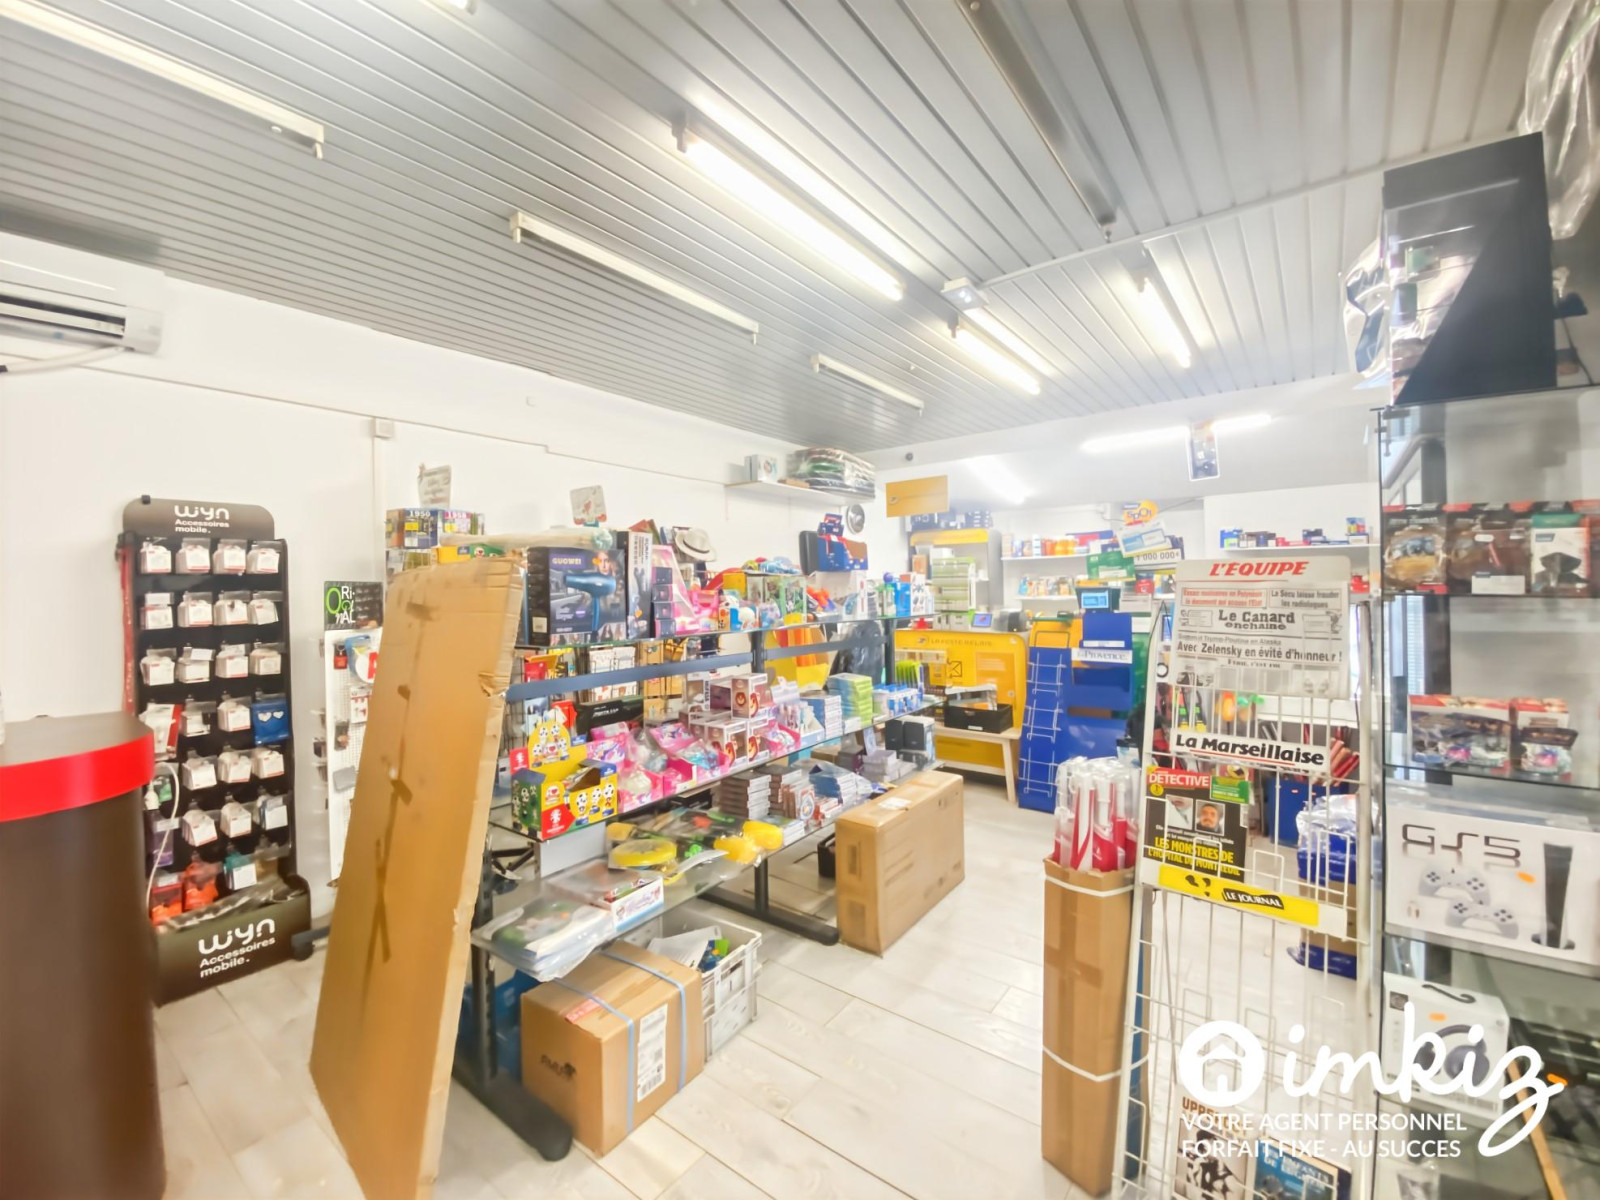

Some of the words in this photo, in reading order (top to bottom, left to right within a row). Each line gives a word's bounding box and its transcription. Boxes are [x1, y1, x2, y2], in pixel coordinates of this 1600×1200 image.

[174, 519, 230, 528] Accessoires
[1218, 610, 1236, 621] Le
[1242, 611, 1296, 624] Canard
[1177, 641, 1197, 652] Avec
[1201, 643, 1242, 658] Zelensky
[1176, 734, 1198, 748] La
[1201, 736, 1324, 766] Marseillaise
[1155, 836, 1170, 850] LES
[1221, 850, 1234, 864] DE
[1196, 859, 1240, 876] MONTEUIL
[1226, 891, 1235, 902] LE
[1238, 892, 1283, 908] JOURNAL
[200, 937, 276, 968] Accessoires
[200, 956, 250, 978] mobile.
